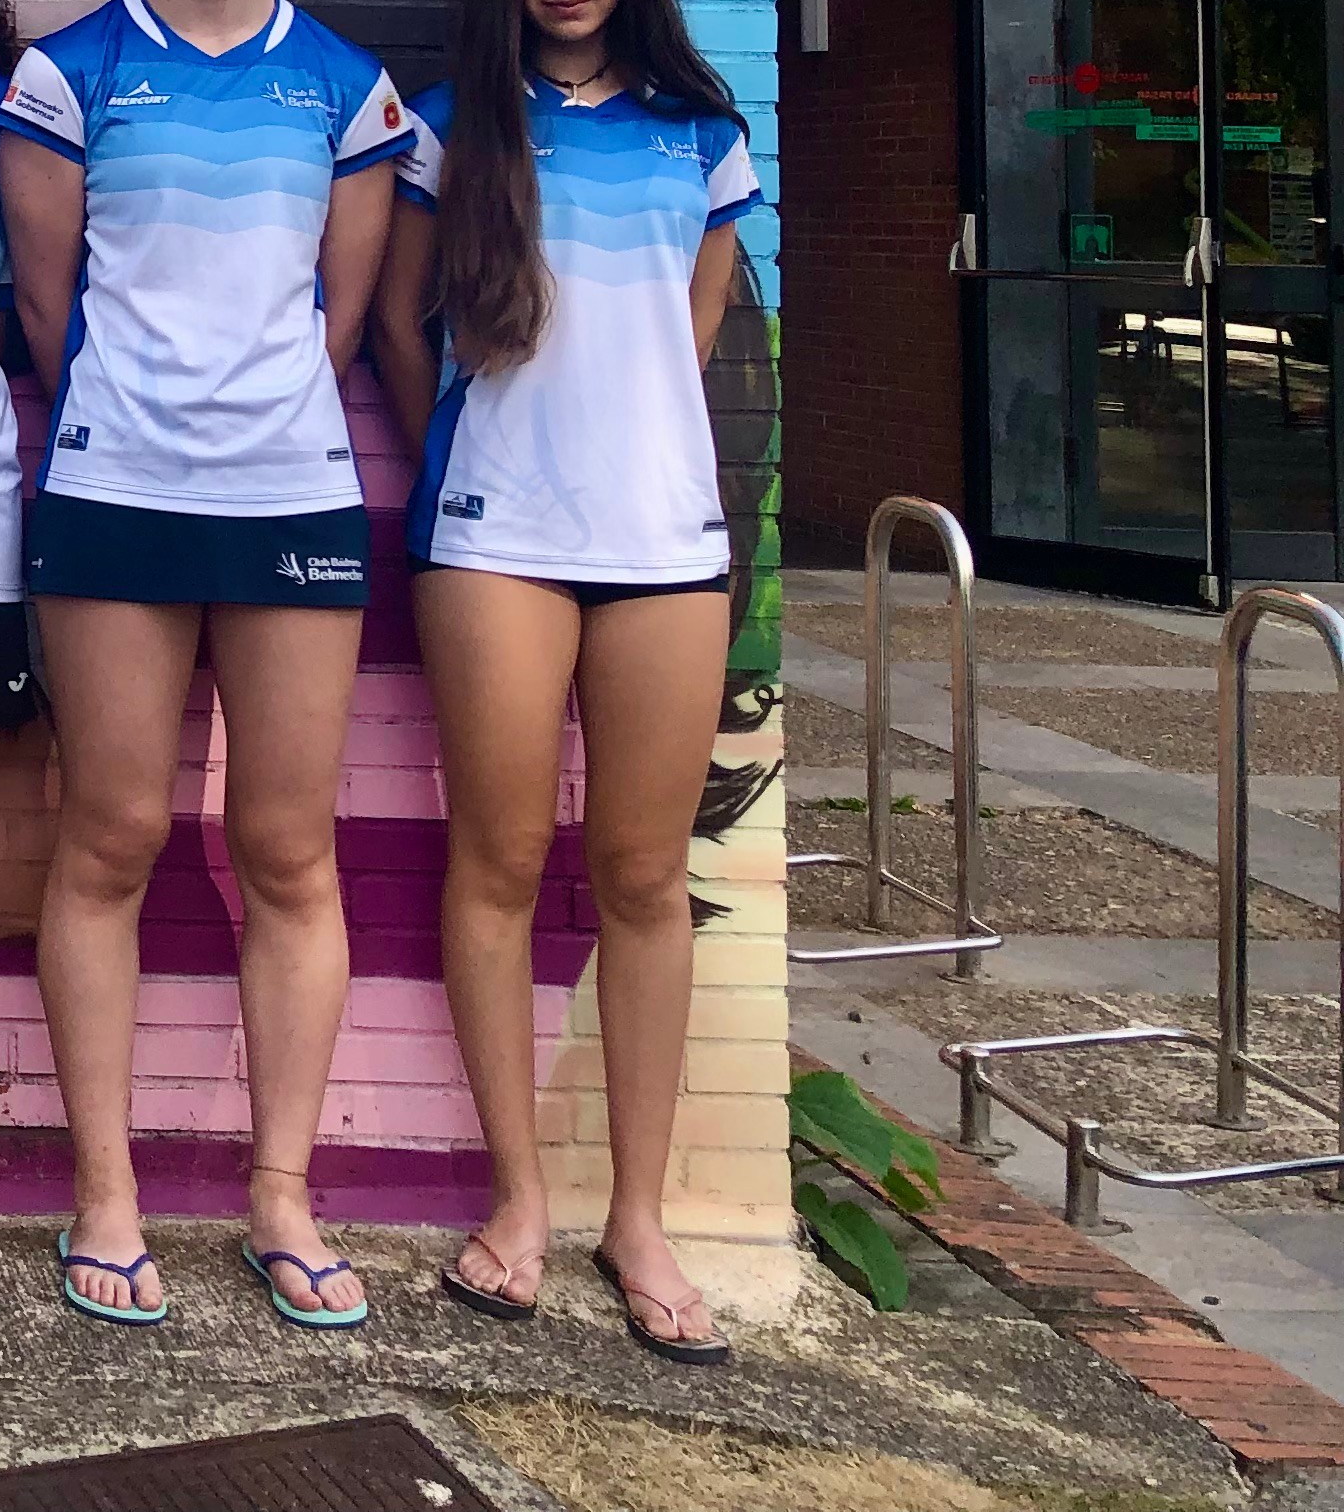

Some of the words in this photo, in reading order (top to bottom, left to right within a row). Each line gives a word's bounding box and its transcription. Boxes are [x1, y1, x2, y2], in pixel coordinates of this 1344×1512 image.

[15, 98, 55, 122] Gobernua
[18, 89, 64, 116] Nafarroako
[107, 95, 172, 106] MERCURY
